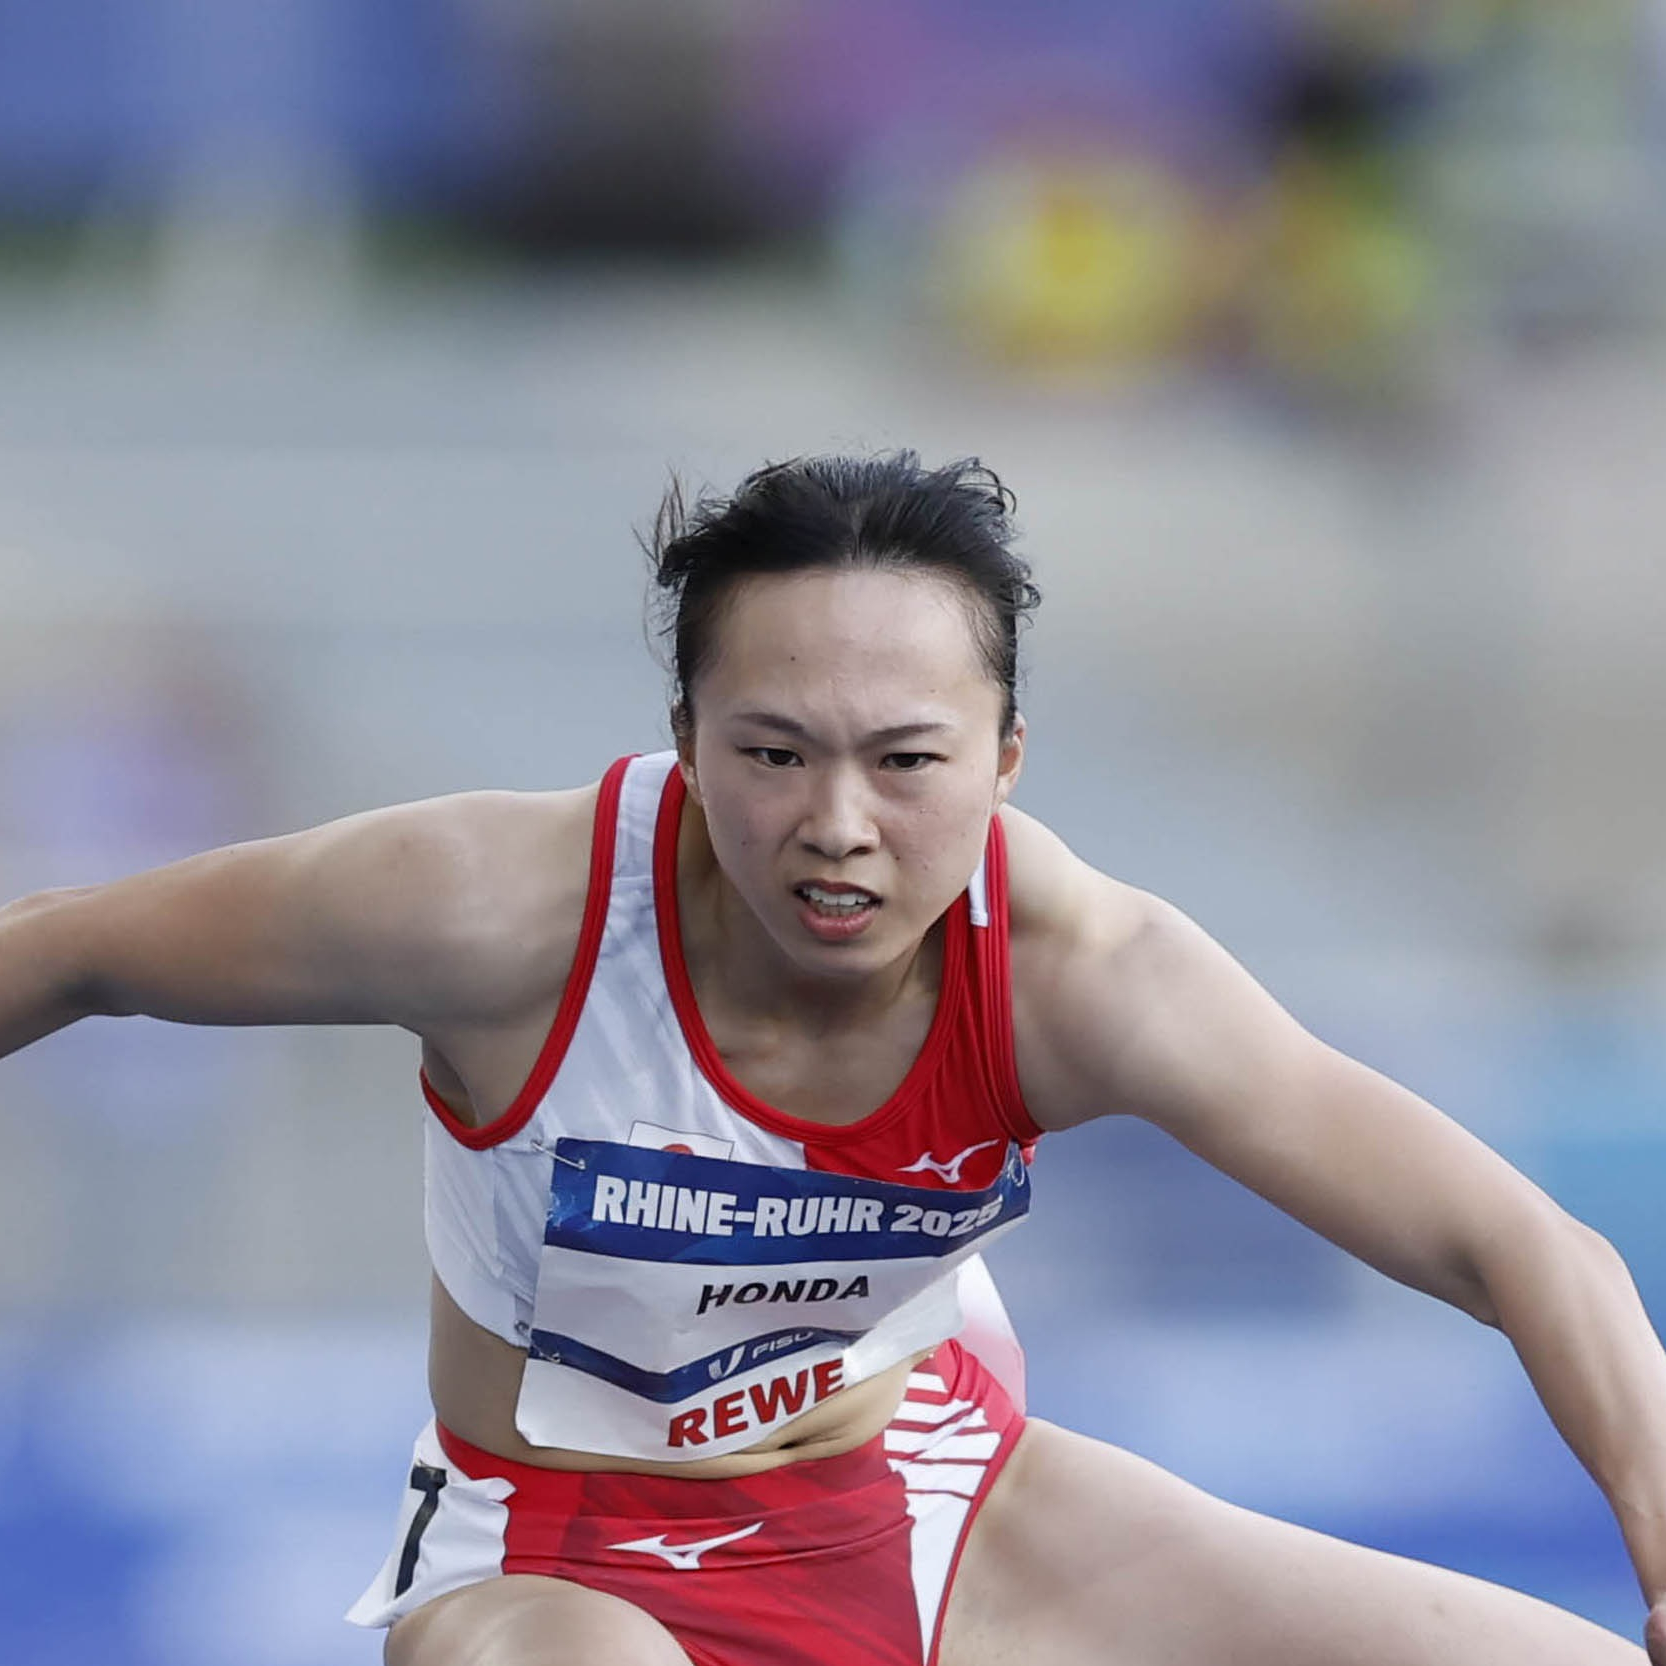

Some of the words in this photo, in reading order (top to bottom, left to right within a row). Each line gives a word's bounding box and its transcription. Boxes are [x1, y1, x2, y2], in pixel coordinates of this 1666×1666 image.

[591, 1174, 884, 1238] RHINE-RUHR
[889, 1194, 1004, 1238] 2025
[695, 1275, 870, 1316] HONDA
[751, 1331, 814, 1360] FISU
[667, 1357, 846, 1448] REWE
